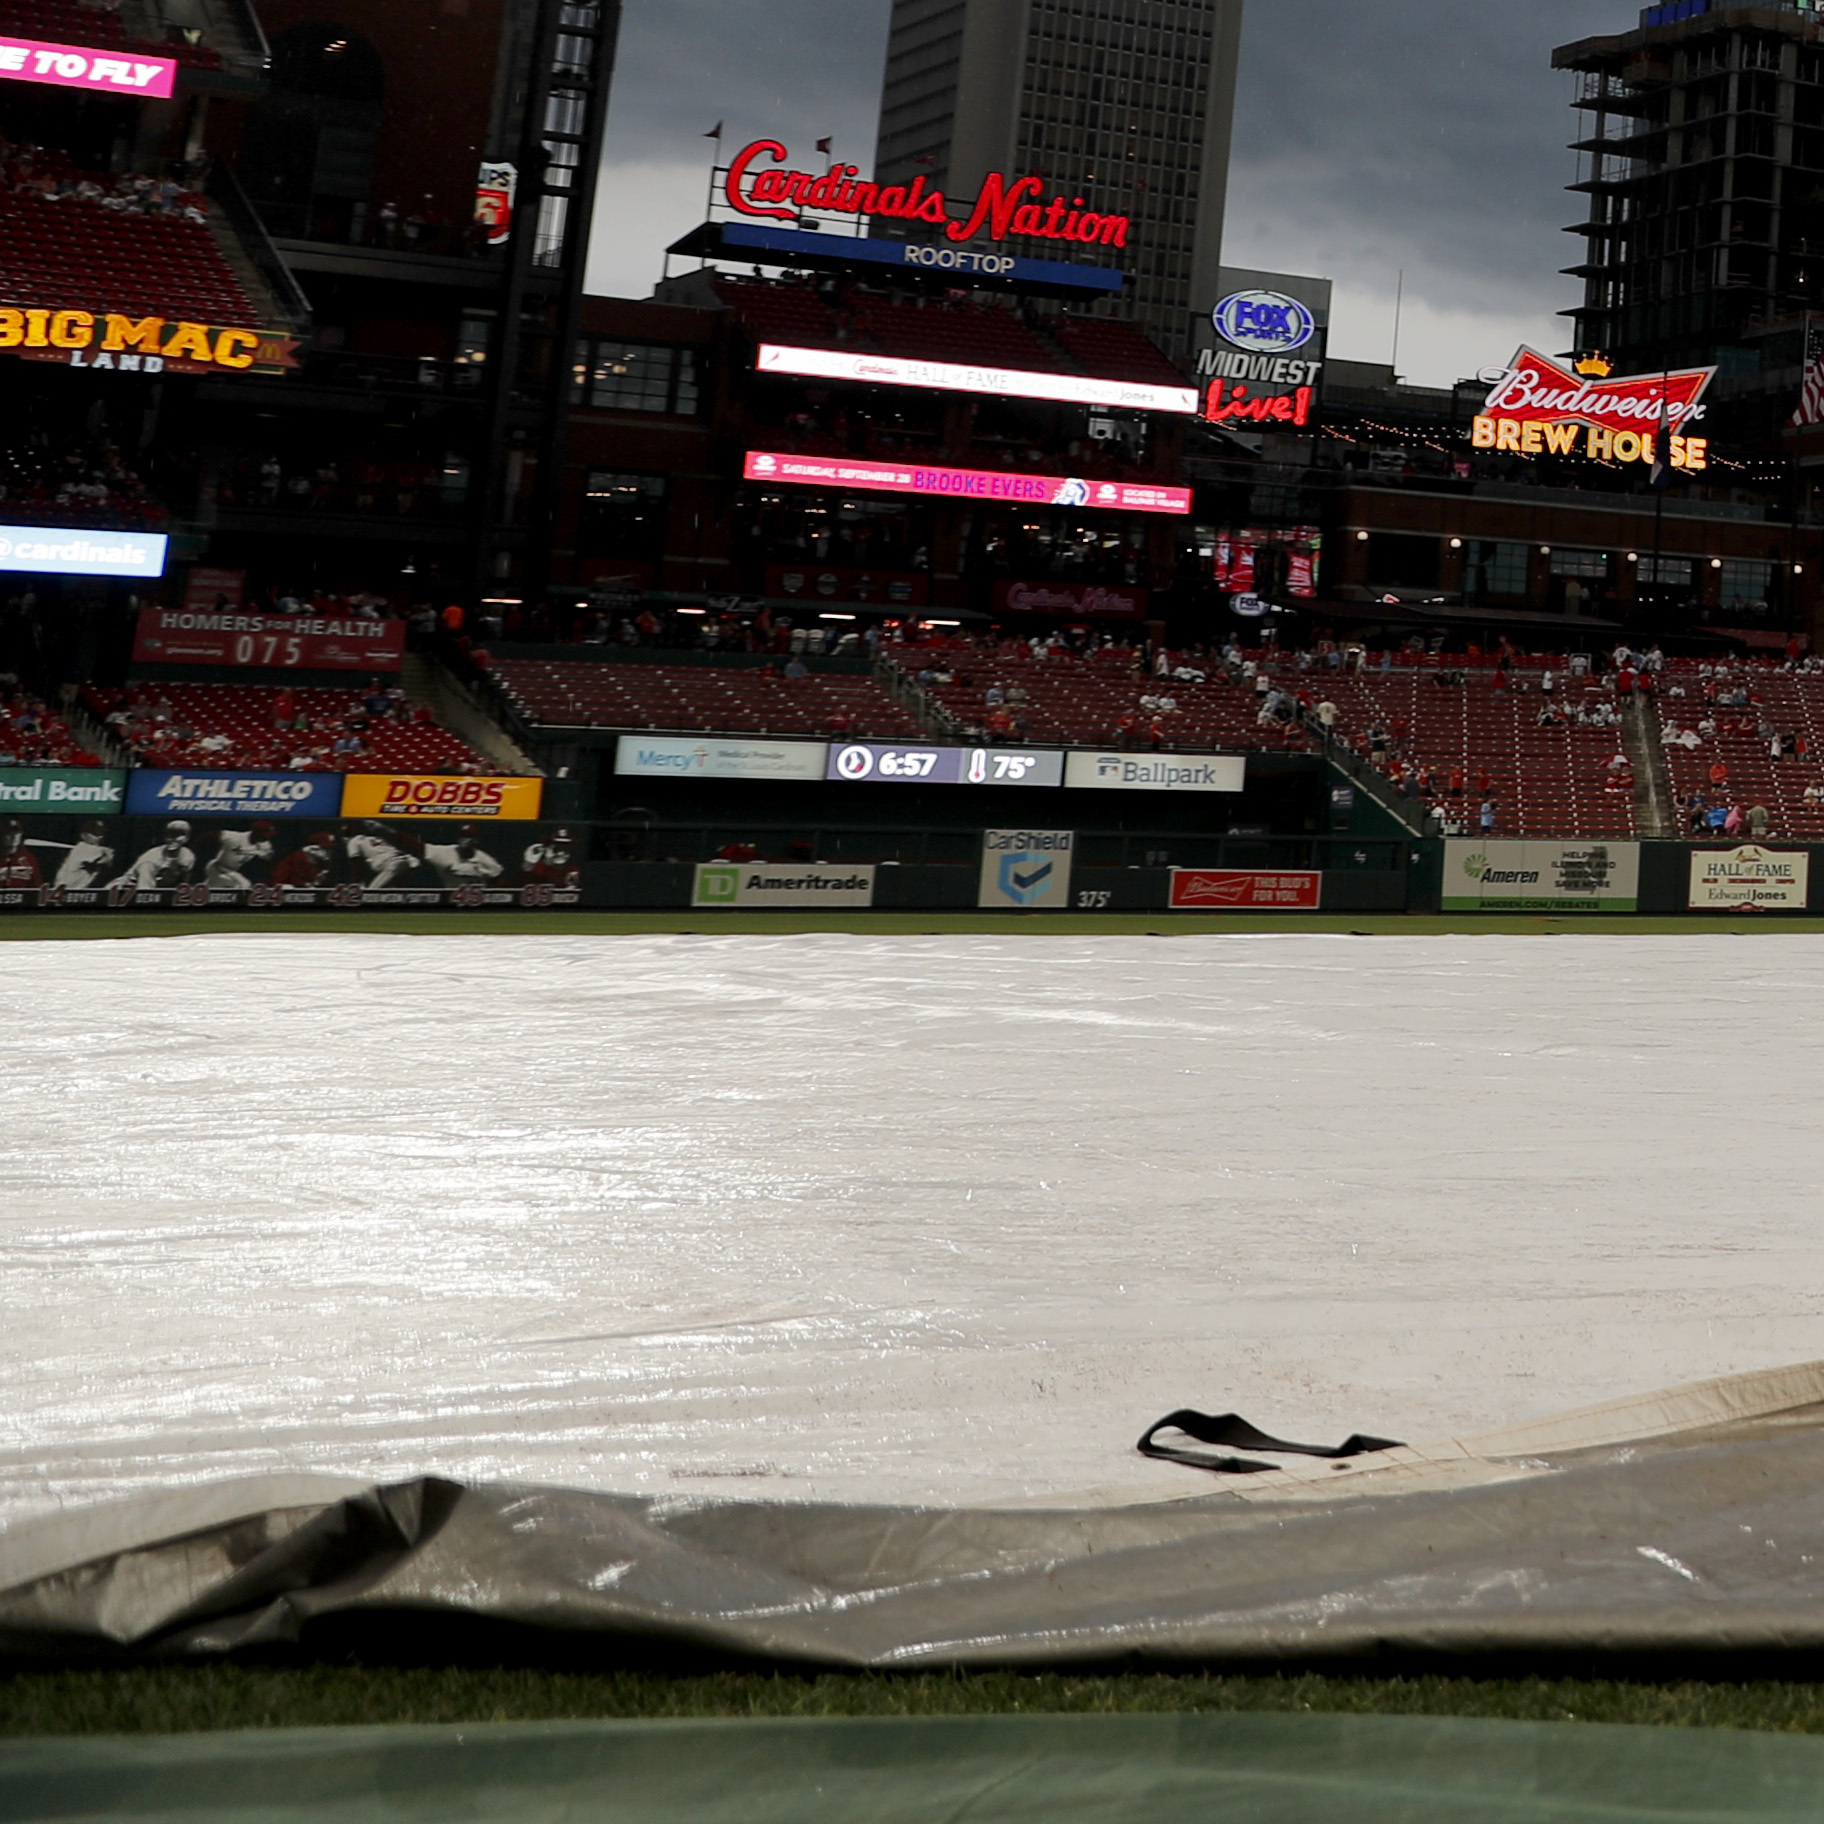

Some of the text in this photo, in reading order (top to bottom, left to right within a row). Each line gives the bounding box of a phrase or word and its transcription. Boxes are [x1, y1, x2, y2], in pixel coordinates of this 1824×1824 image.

[726, 139, 1131, 249] Cardinals Nation
[904, 243, 1015, 275] ROOFTOP
[101, 312, 261, 369] MAC
[70, 349, 165, 374] LAND
[1199, 348, 1322, 387] MIDWEST
[1471, 415, 1579, 458] BREW
[878, 752, 938, 777] 6:57
[1122, 761, 1217, 787] Ballpark
[47, 780, 123, 802] Bank
[157, 775, 313, 801] ATHLETICO
[386, 780, 504, 805] DOBBS
[167, 800, 297, 813] PHYSICAL THERAPY
[984, 830, 1071, 852] CarShield
[746, 873, 870, 892] Ameritrade
[1480, 867, 1539, 884] Ameren
[1706, 862, 1793, 878] HALL FAME
[1252, 889, 1272, 902] FOR
